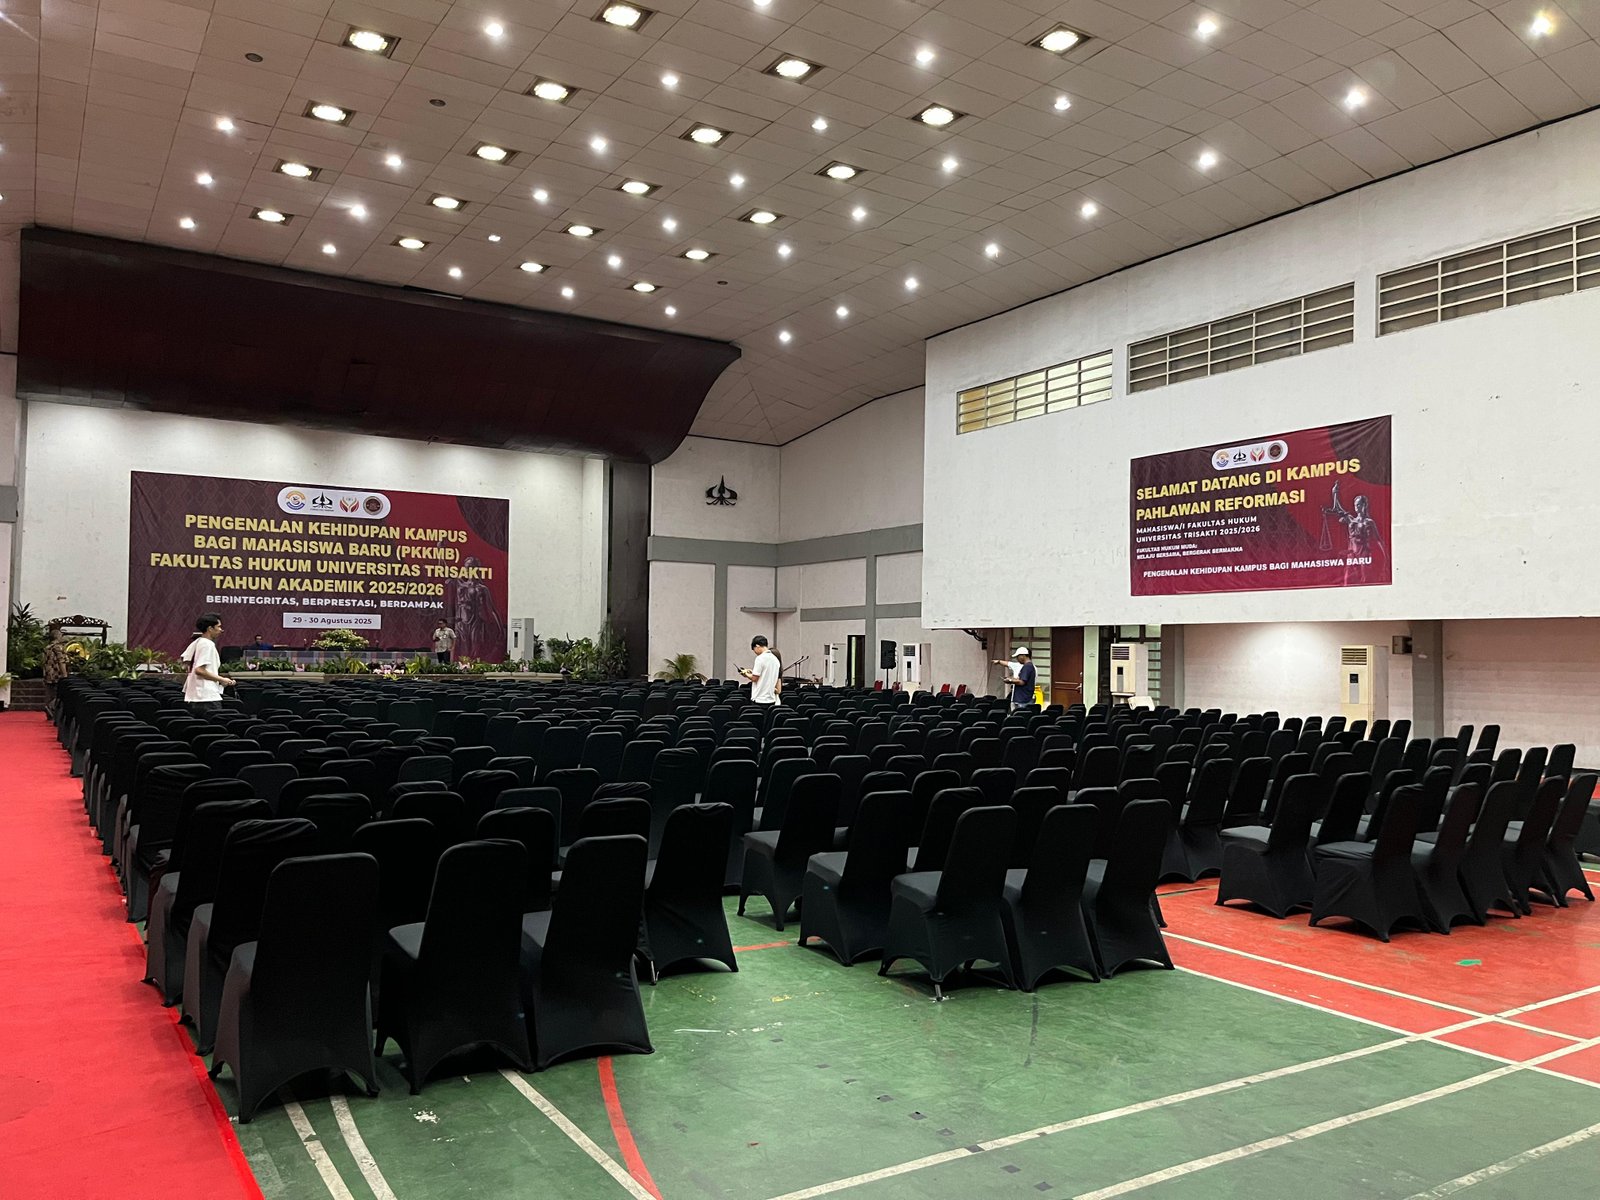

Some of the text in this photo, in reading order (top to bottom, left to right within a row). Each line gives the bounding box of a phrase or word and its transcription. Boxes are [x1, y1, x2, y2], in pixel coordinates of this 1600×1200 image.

[1136, 458, 1361, 501] SELAMAT DATANG DI KAMPUS
[1136, 489, 1305, 521] PAHLAWAN REFORMASI
[185, 514, 468, 543] PENGENALAN KEHIDUPAN KAMPUS
[1136, 516, 1257, 534] MAHASISWA/I FAKULTAS HUKUM
[1136, 525, 1260, 543] UNIVERSITAS TRISAKTI 2025/2026
[194, 535, 460, 563] BAGI MAHASISWA BARU (PKKMB)
[150, 552, 492, 580] FAKULTAS HUKUM UNIVERSITAS TRISAKTI
[1143, 556, 1372, 578] PENGENALAN KEHIDUPAN KAMPUS BAGI MAHASISWA BARU
[212, 575, 444, 596] TAHUN AKADEMIK 2025/2026
[206, 595, 444, 609] BERINTEGRITAS, BERPRESTASI, BERDAMPAK
[292, 616, 302, 624] 29
[321, 617, 352, 625] Agustus
